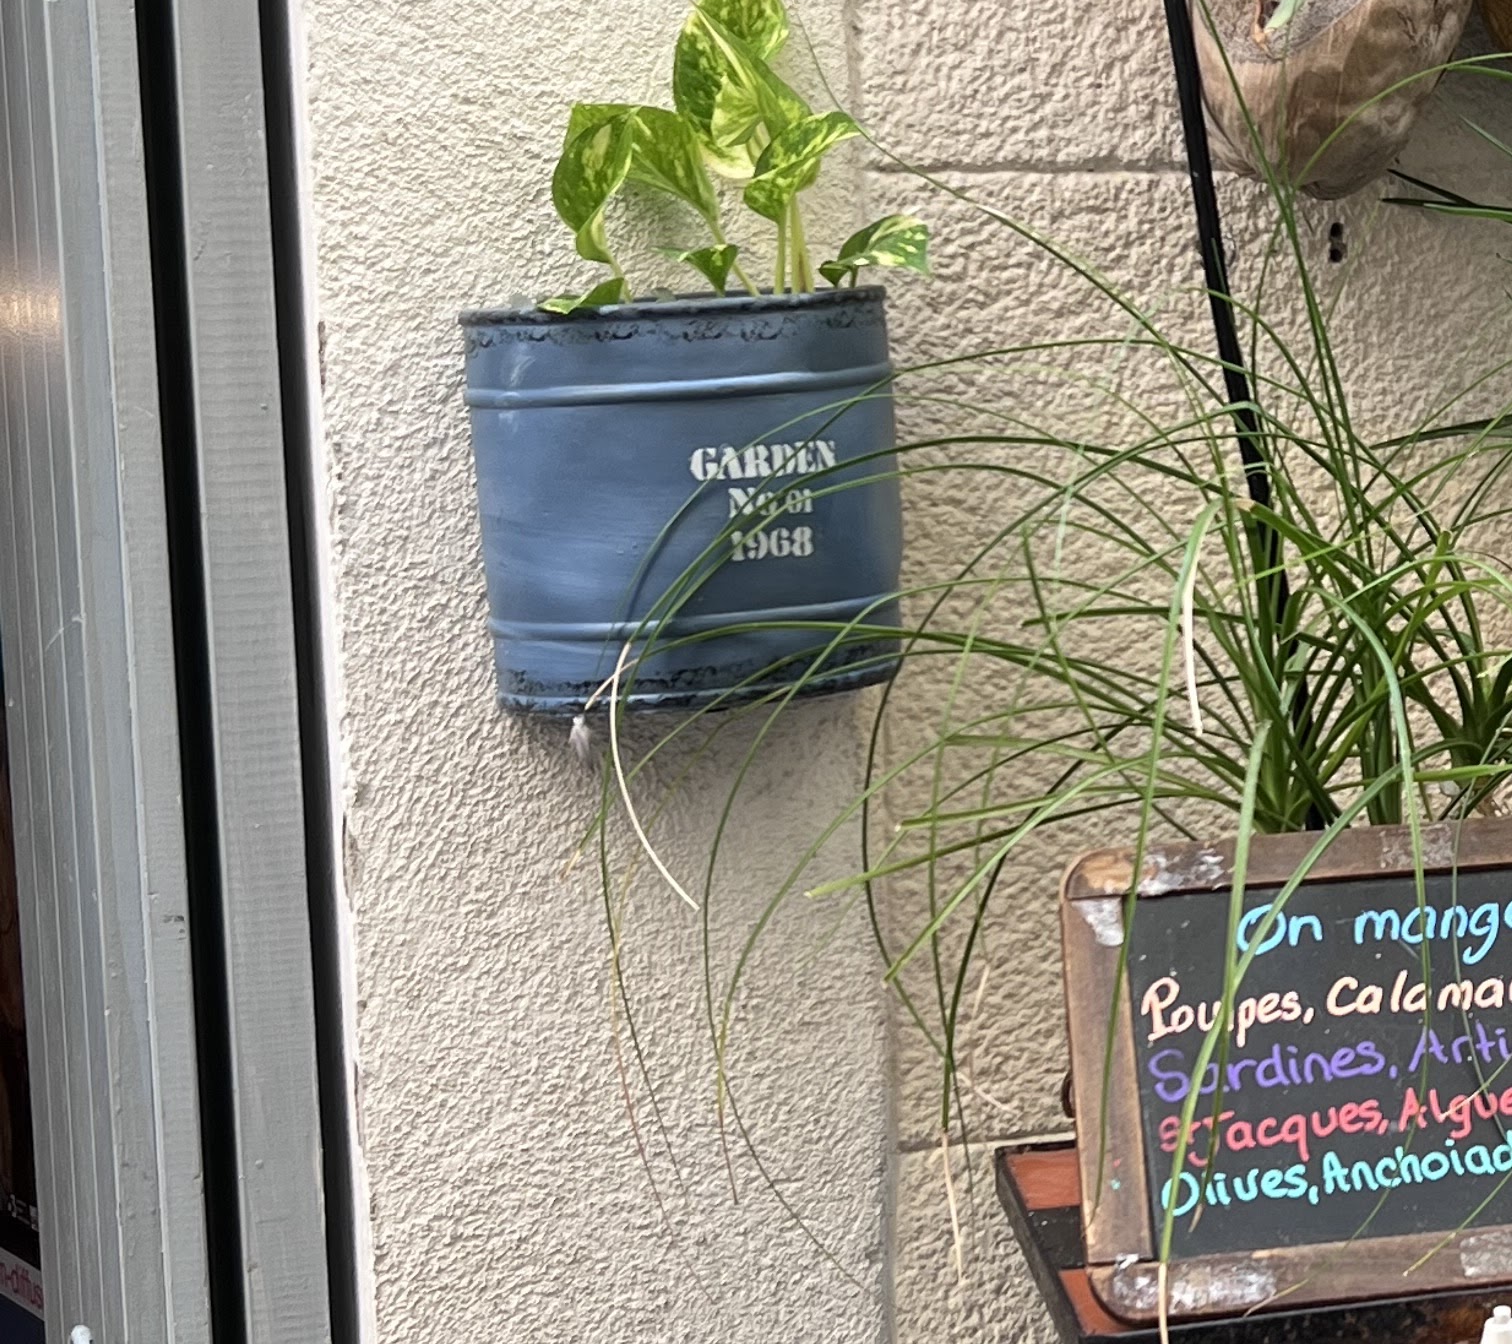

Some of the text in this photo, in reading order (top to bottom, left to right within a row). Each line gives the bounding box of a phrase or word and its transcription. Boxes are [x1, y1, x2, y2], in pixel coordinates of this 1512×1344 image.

[689, 440, 837, 482] GARDEN
[730, 526, 814, 562] 1968
[1236, 903, 1323, 956] On
